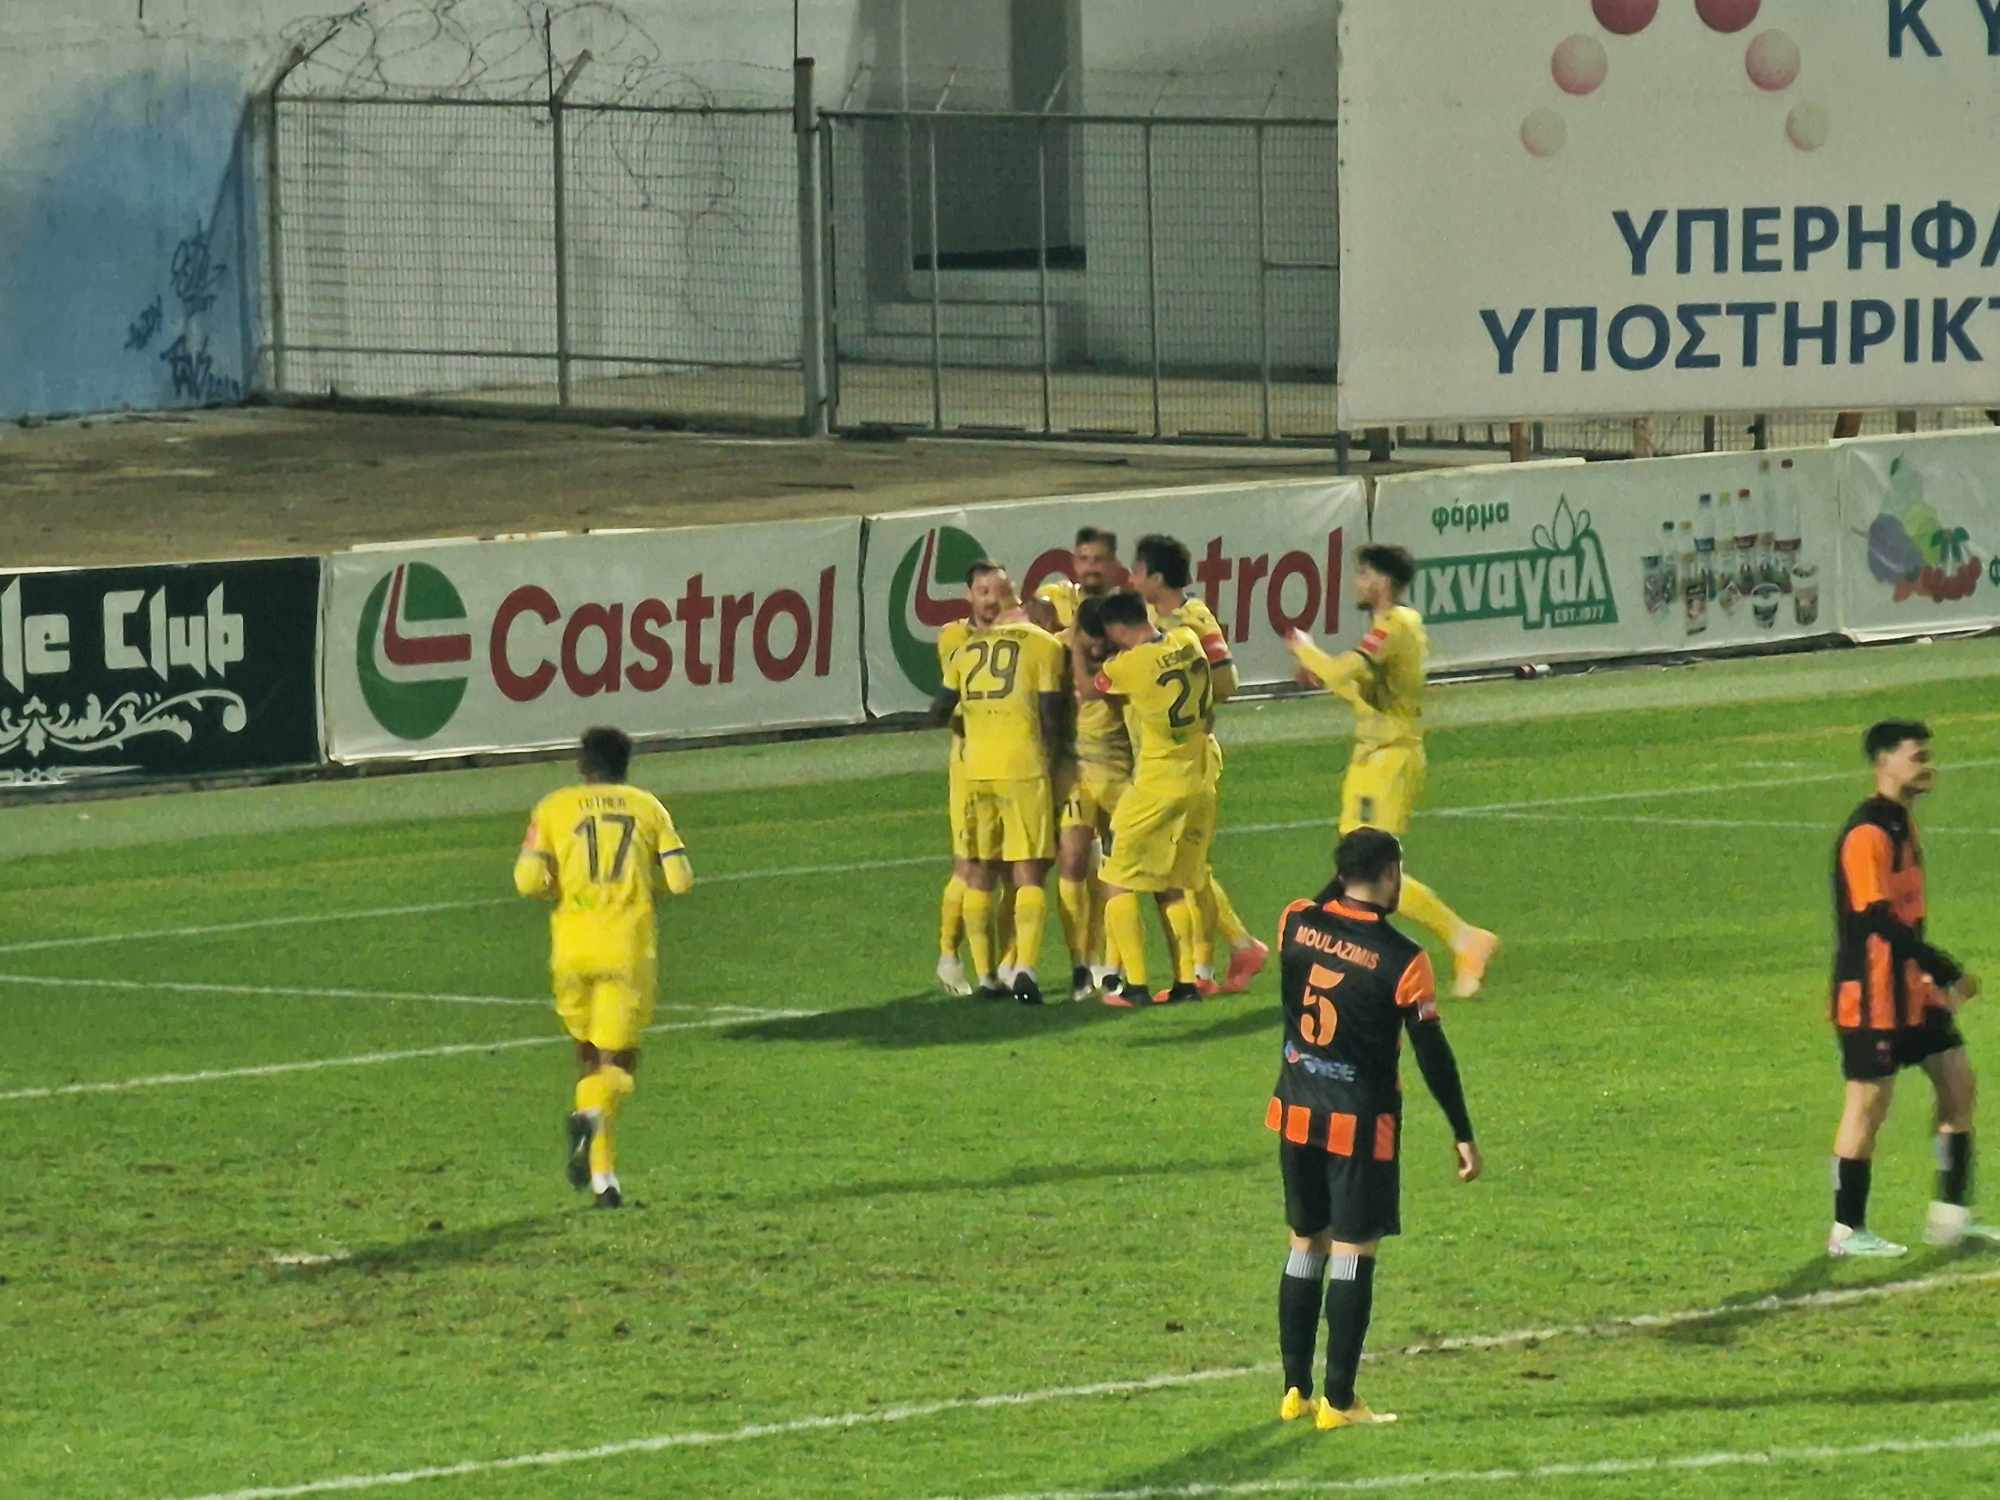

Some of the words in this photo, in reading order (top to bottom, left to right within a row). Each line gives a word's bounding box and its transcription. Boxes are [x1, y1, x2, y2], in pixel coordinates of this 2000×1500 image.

[1431, 498, 1510, 535] φάρμα
[103, 580, 245, 683] Club
[489, 565, 836, 702] Castrol
[965, 639, 1020, 700] 29
[573, 812, 637, 883] 17
[1299, 962, 1346, 1047] 5
